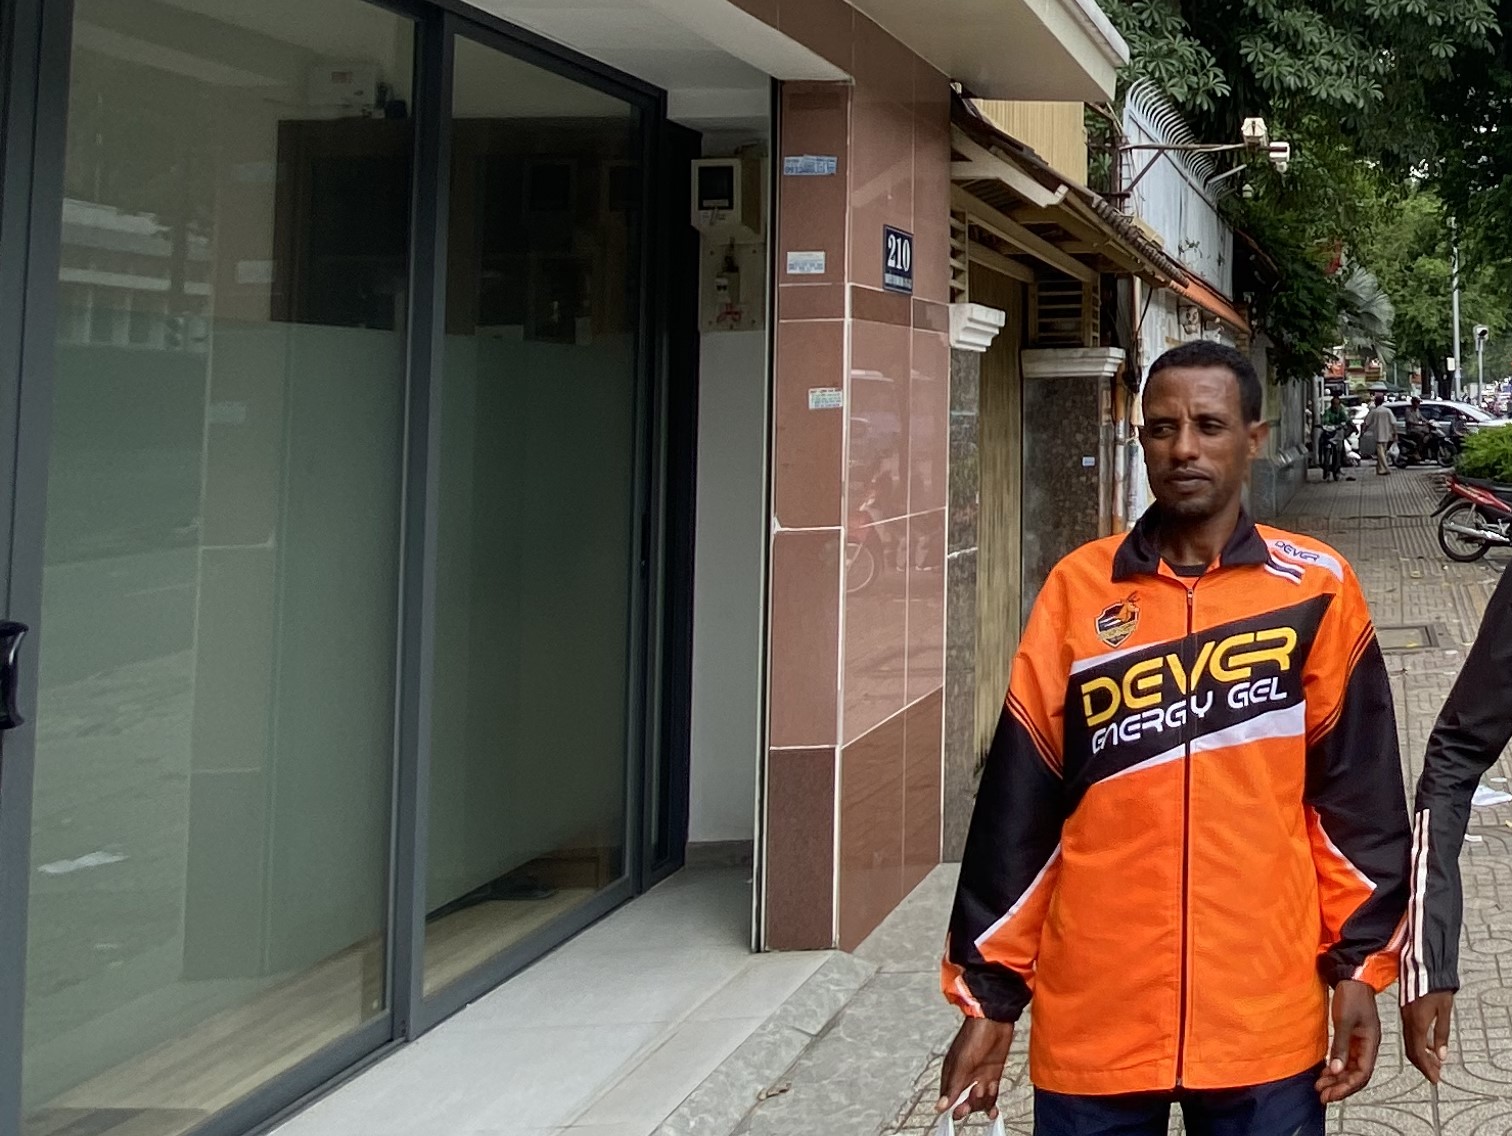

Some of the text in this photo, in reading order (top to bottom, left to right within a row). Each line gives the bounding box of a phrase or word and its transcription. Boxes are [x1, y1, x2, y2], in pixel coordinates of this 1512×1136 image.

[887, 234, 911, 272] 210
[1274, 540, 1321, 563] DEVER
[1081, 626, 1298, 728] DEVER
[1091, 676, 1288, 755] ENERGY GEL
